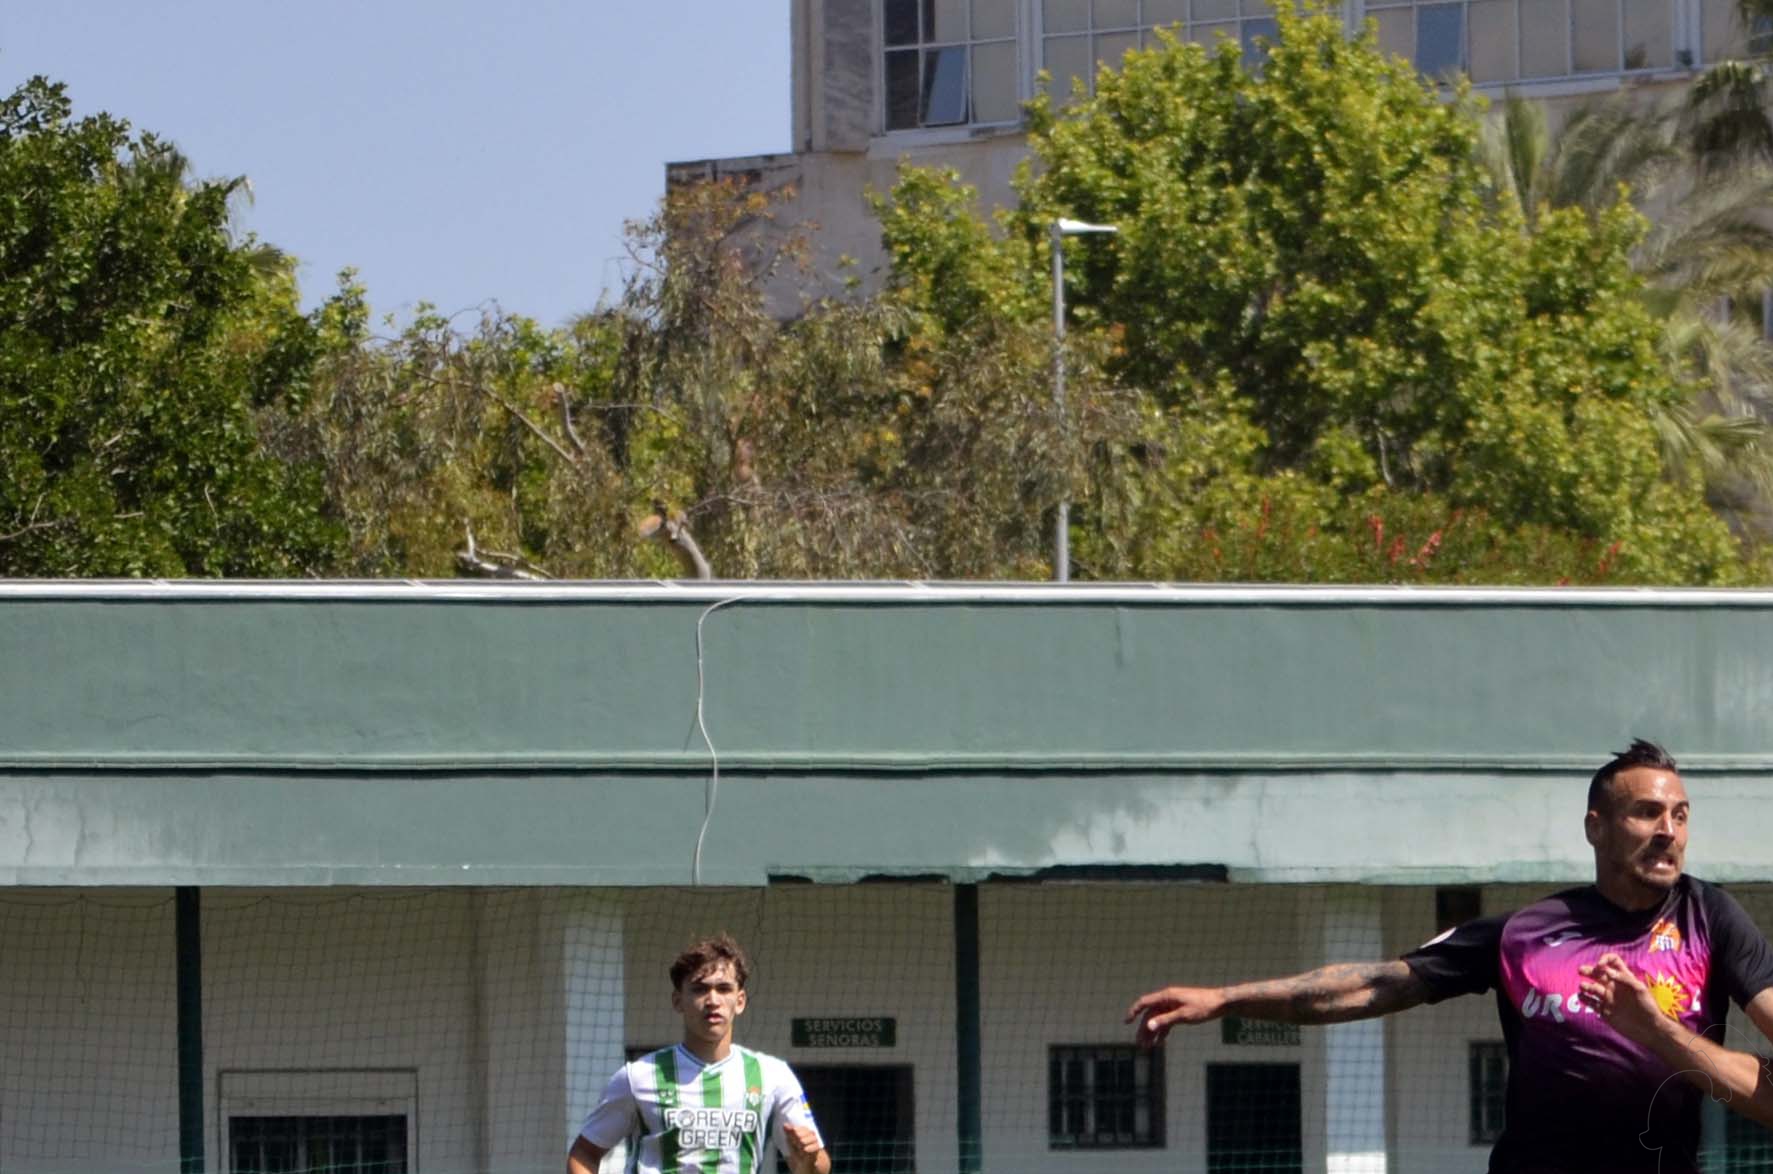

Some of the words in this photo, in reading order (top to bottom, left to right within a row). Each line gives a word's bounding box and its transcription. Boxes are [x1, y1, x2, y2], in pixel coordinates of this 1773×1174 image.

[804, 1020, 882, 1033] SERVICIOS
[666, 1109, 757, 1131] FOREVER
[681, 1127, 742, 1148] GREEN
